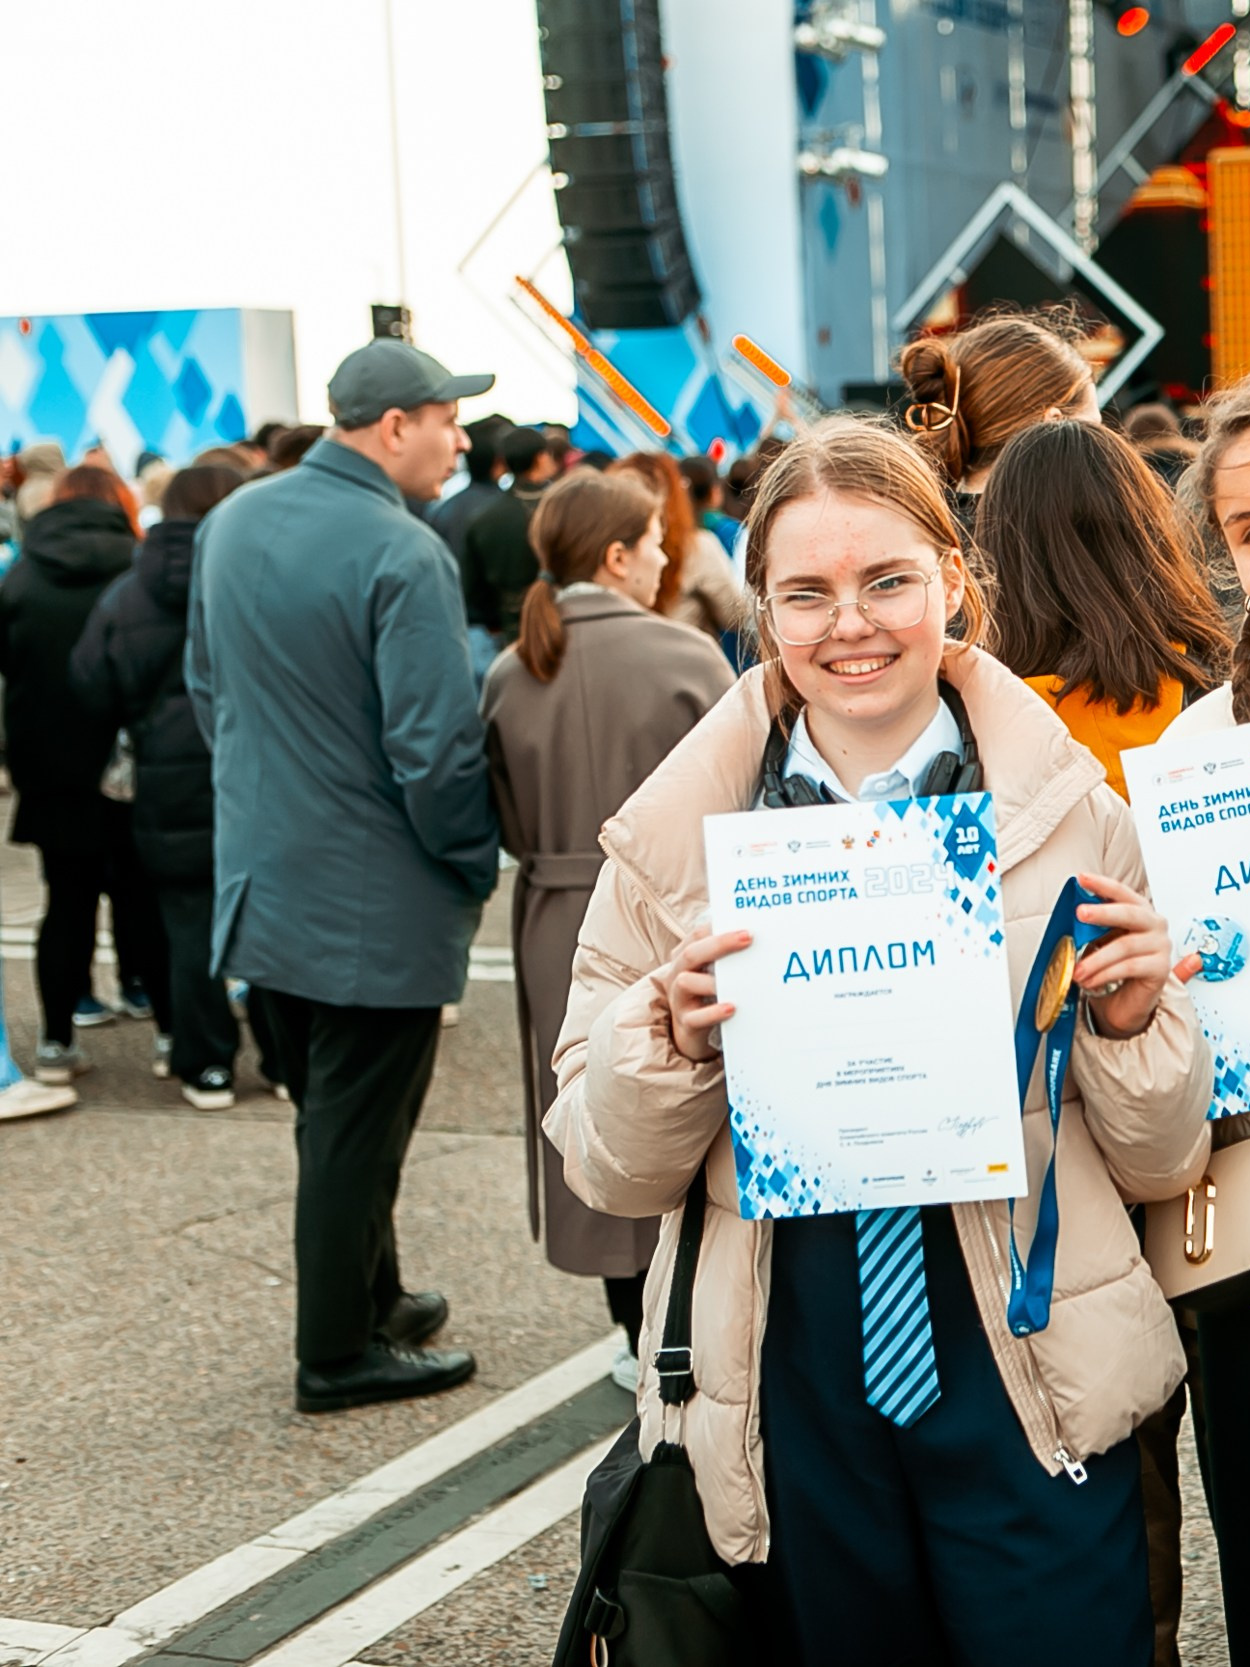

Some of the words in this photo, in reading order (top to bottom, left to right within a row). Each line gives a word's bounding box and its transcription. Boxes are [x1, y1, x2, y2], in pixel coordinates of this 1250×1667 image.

[1158, 799, 1200, 820] ДЕНЬ
[1161, 813, 1215, 833] ВИДОВ
[956, 826, 979, 844] 10
[957, 844, 980, 855] ЛЕТ
[734, 877, 777, 894] ДЕНЬ
[783, 870, 849, 887] ЗИМНИХ
[864, 862, 957, 898] 2024
[735, 893, 792, 909] ВИДОВ
[798, 886, 858, 903] СПОРТА
[783, 940, 936, 983] ДИПЛОМ
